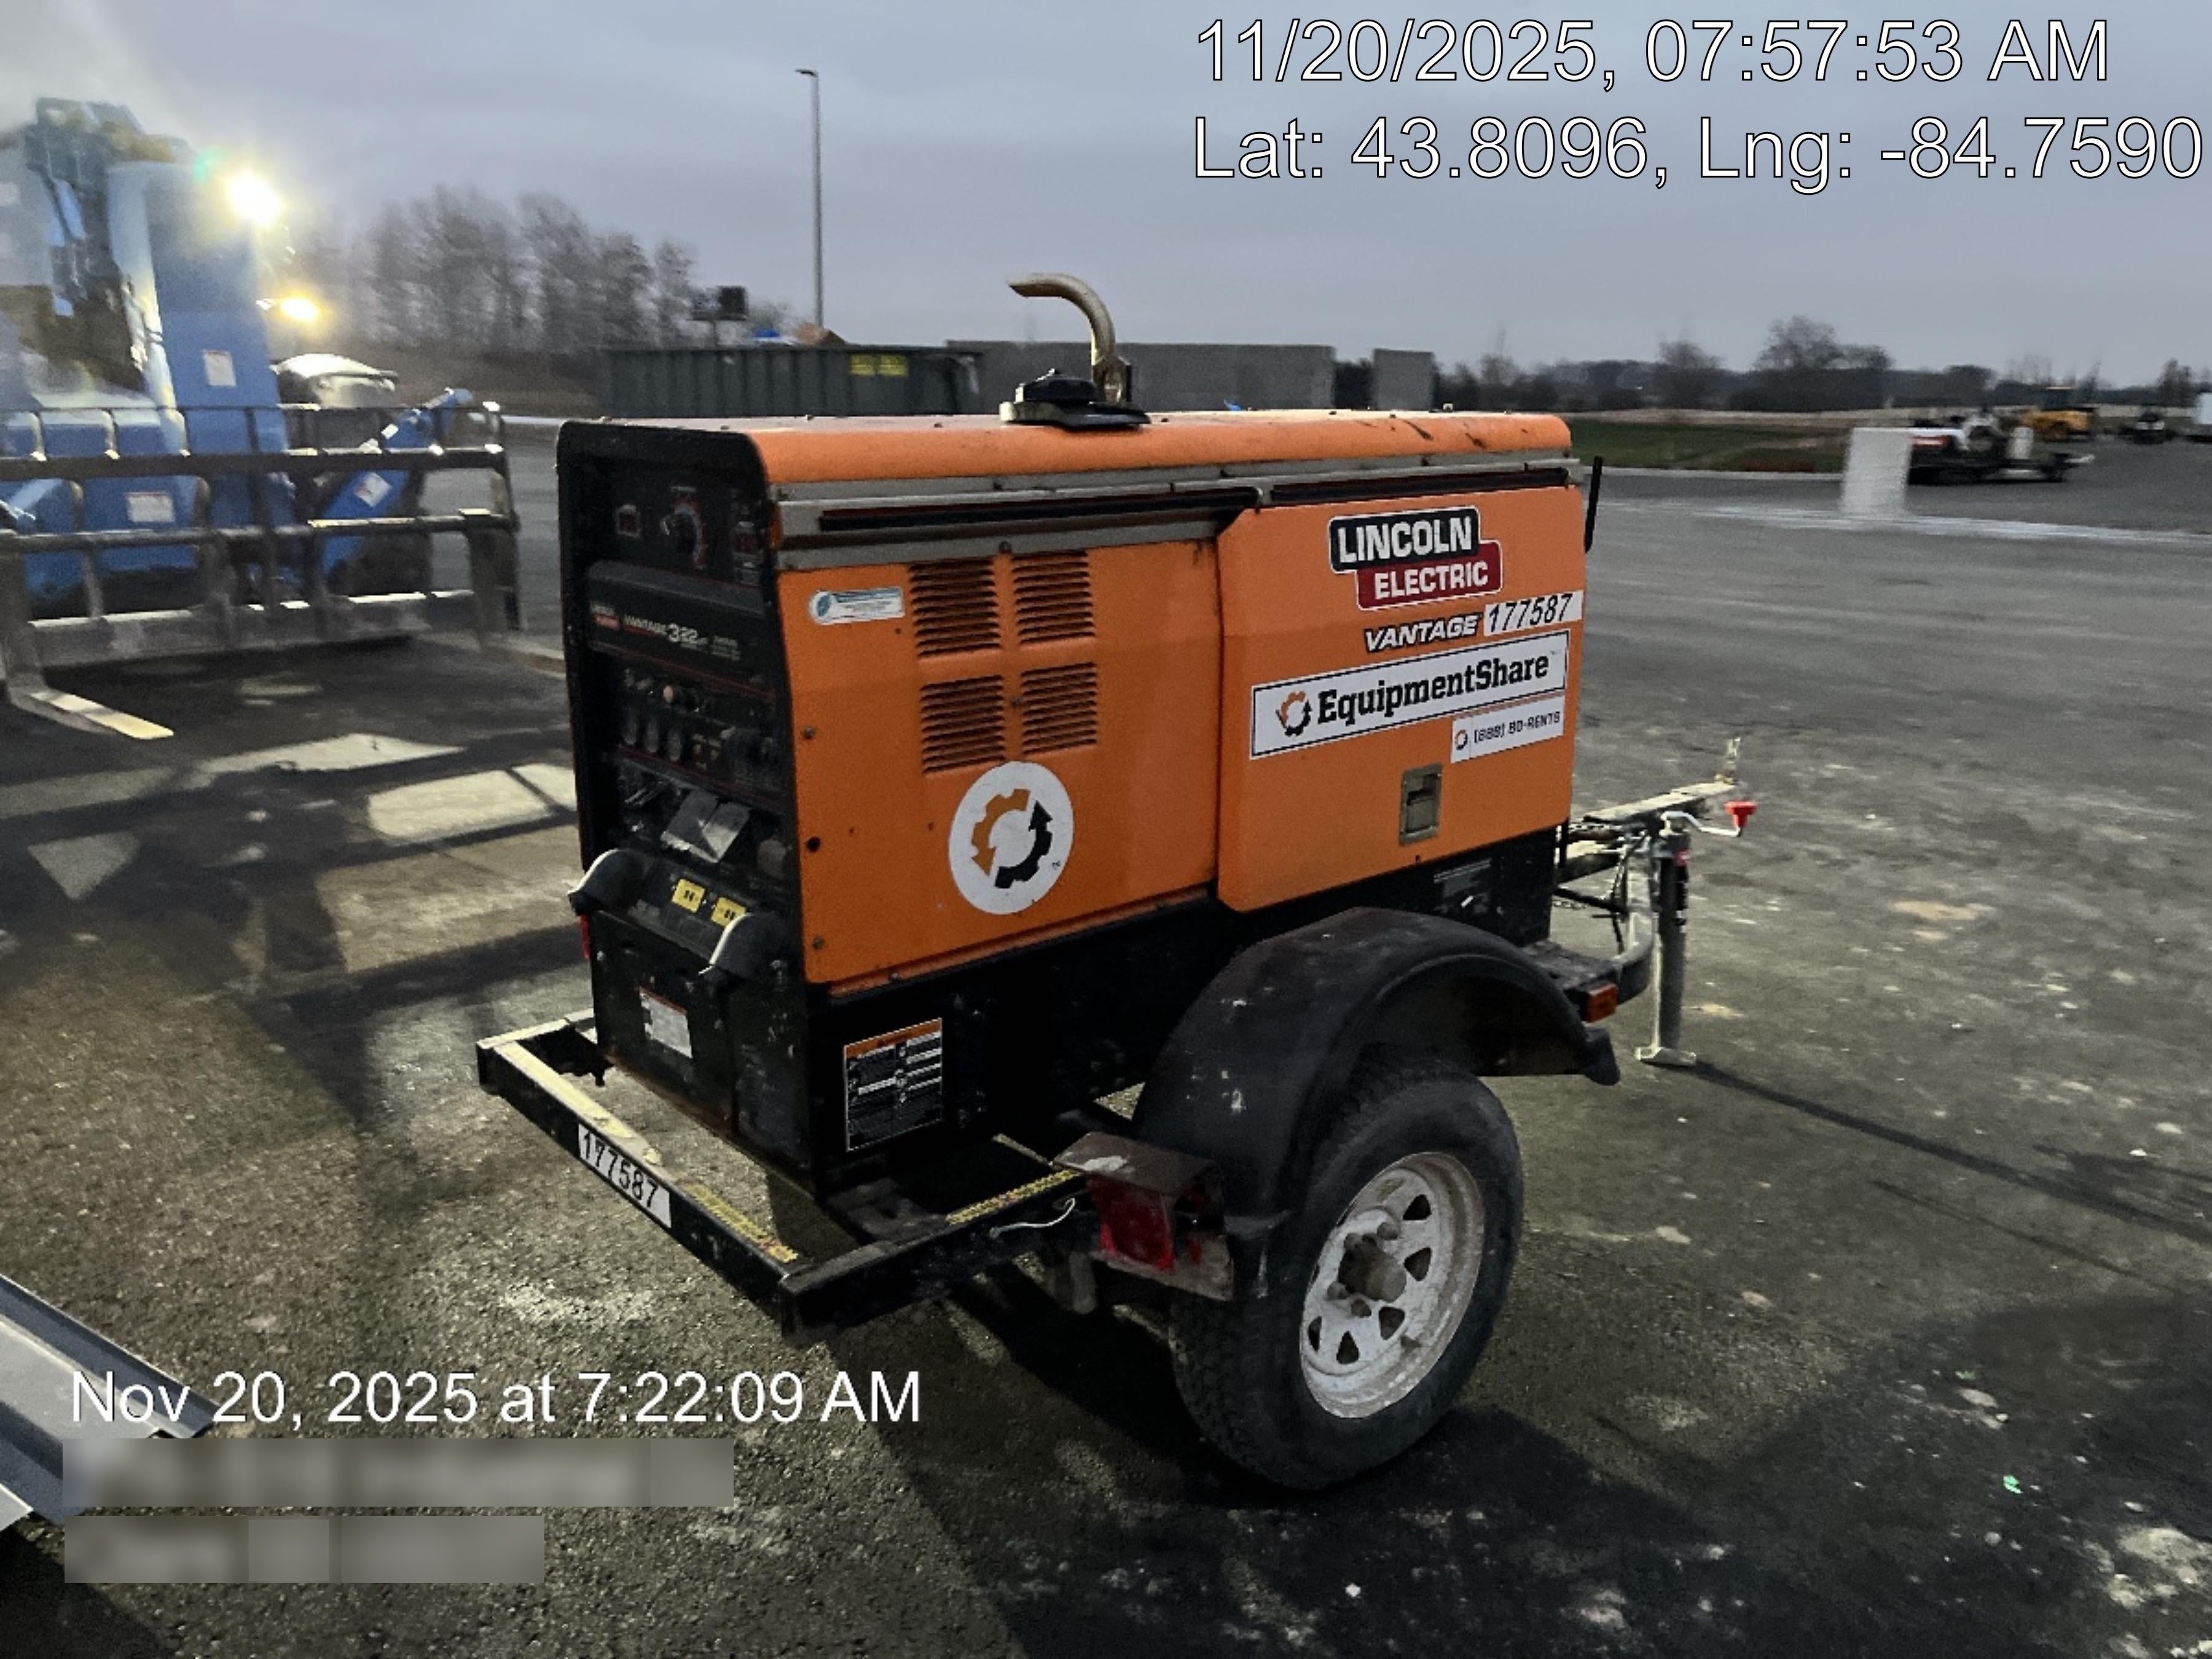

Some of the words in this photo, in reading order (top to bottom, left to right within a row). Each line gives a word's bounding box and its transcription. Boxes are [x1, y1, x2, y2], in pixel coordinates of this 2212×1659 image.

[1338, 516, 1472, 563] LINCOLN
[1374, 560, 1488, 600] ELECTRIC
[1364, 613, 1481, 653] VANTAGE
[1488, 593, 1573, 633] 177587
[1317, 656, 1549, 726] EquipmentShare
[583, 1131, 659, 1209] 177587
